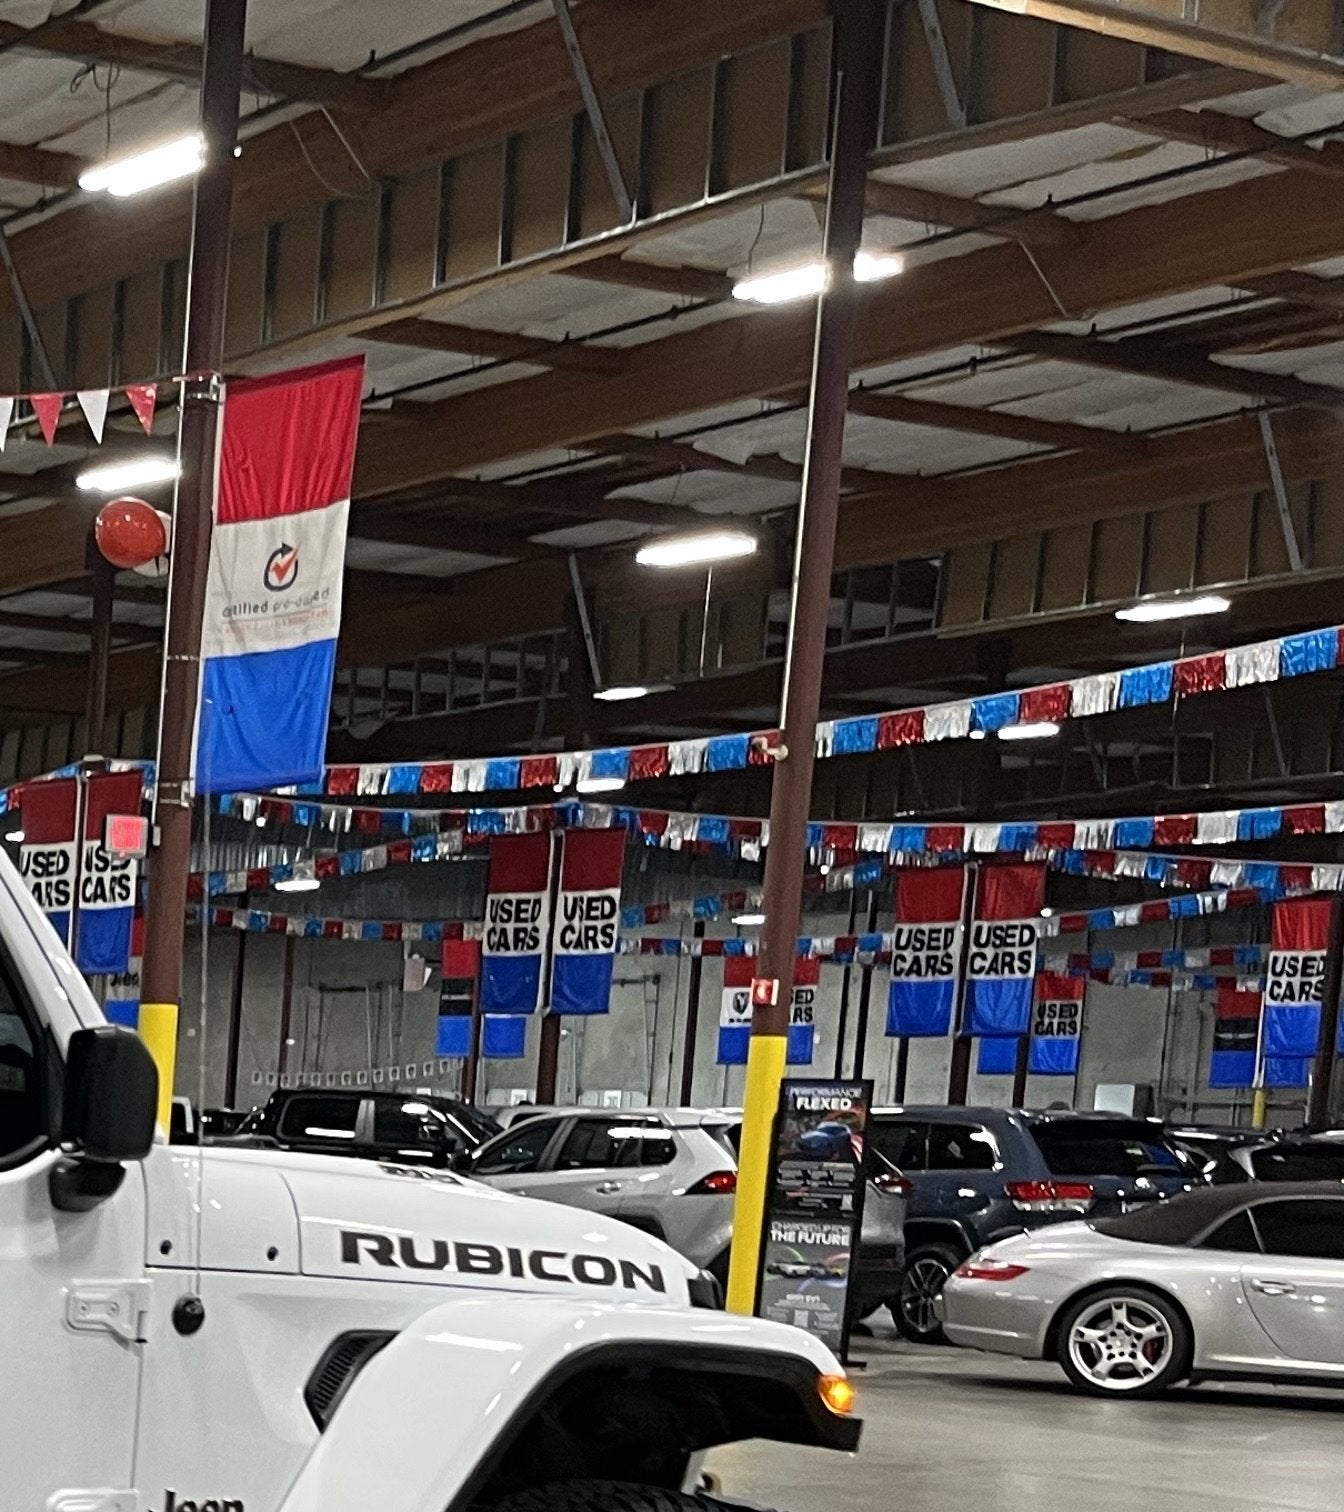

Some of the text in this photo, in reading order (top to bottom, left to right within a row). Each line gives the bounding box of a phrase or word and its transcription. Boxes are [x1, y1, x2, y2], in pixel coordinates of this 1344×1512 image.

[31, 879, 70, 906] ARS
[490, 898, 542, 923] USED
[564, 896, 617, 921] USED
[486, 926, 540, 951] CARS
[559, 923, 615, 950] CARS
[895, 928, 955, 951] USED
[973, 924, 1036, 948] USED
[893, 952, 954, 976] CARS
[969, 950, 1032, 975] CARS
[792, 1007, 814, 1023] RS
[1037, 1003, 1079, 1019] USED
[1034, 1020, 1078, 1036] CARS
[796, 1096, 853, 1111] FLEXED
[771, 1230, 851, 1247] THE FUTURE
[340, 1230, 667, 1293] RUBICON
